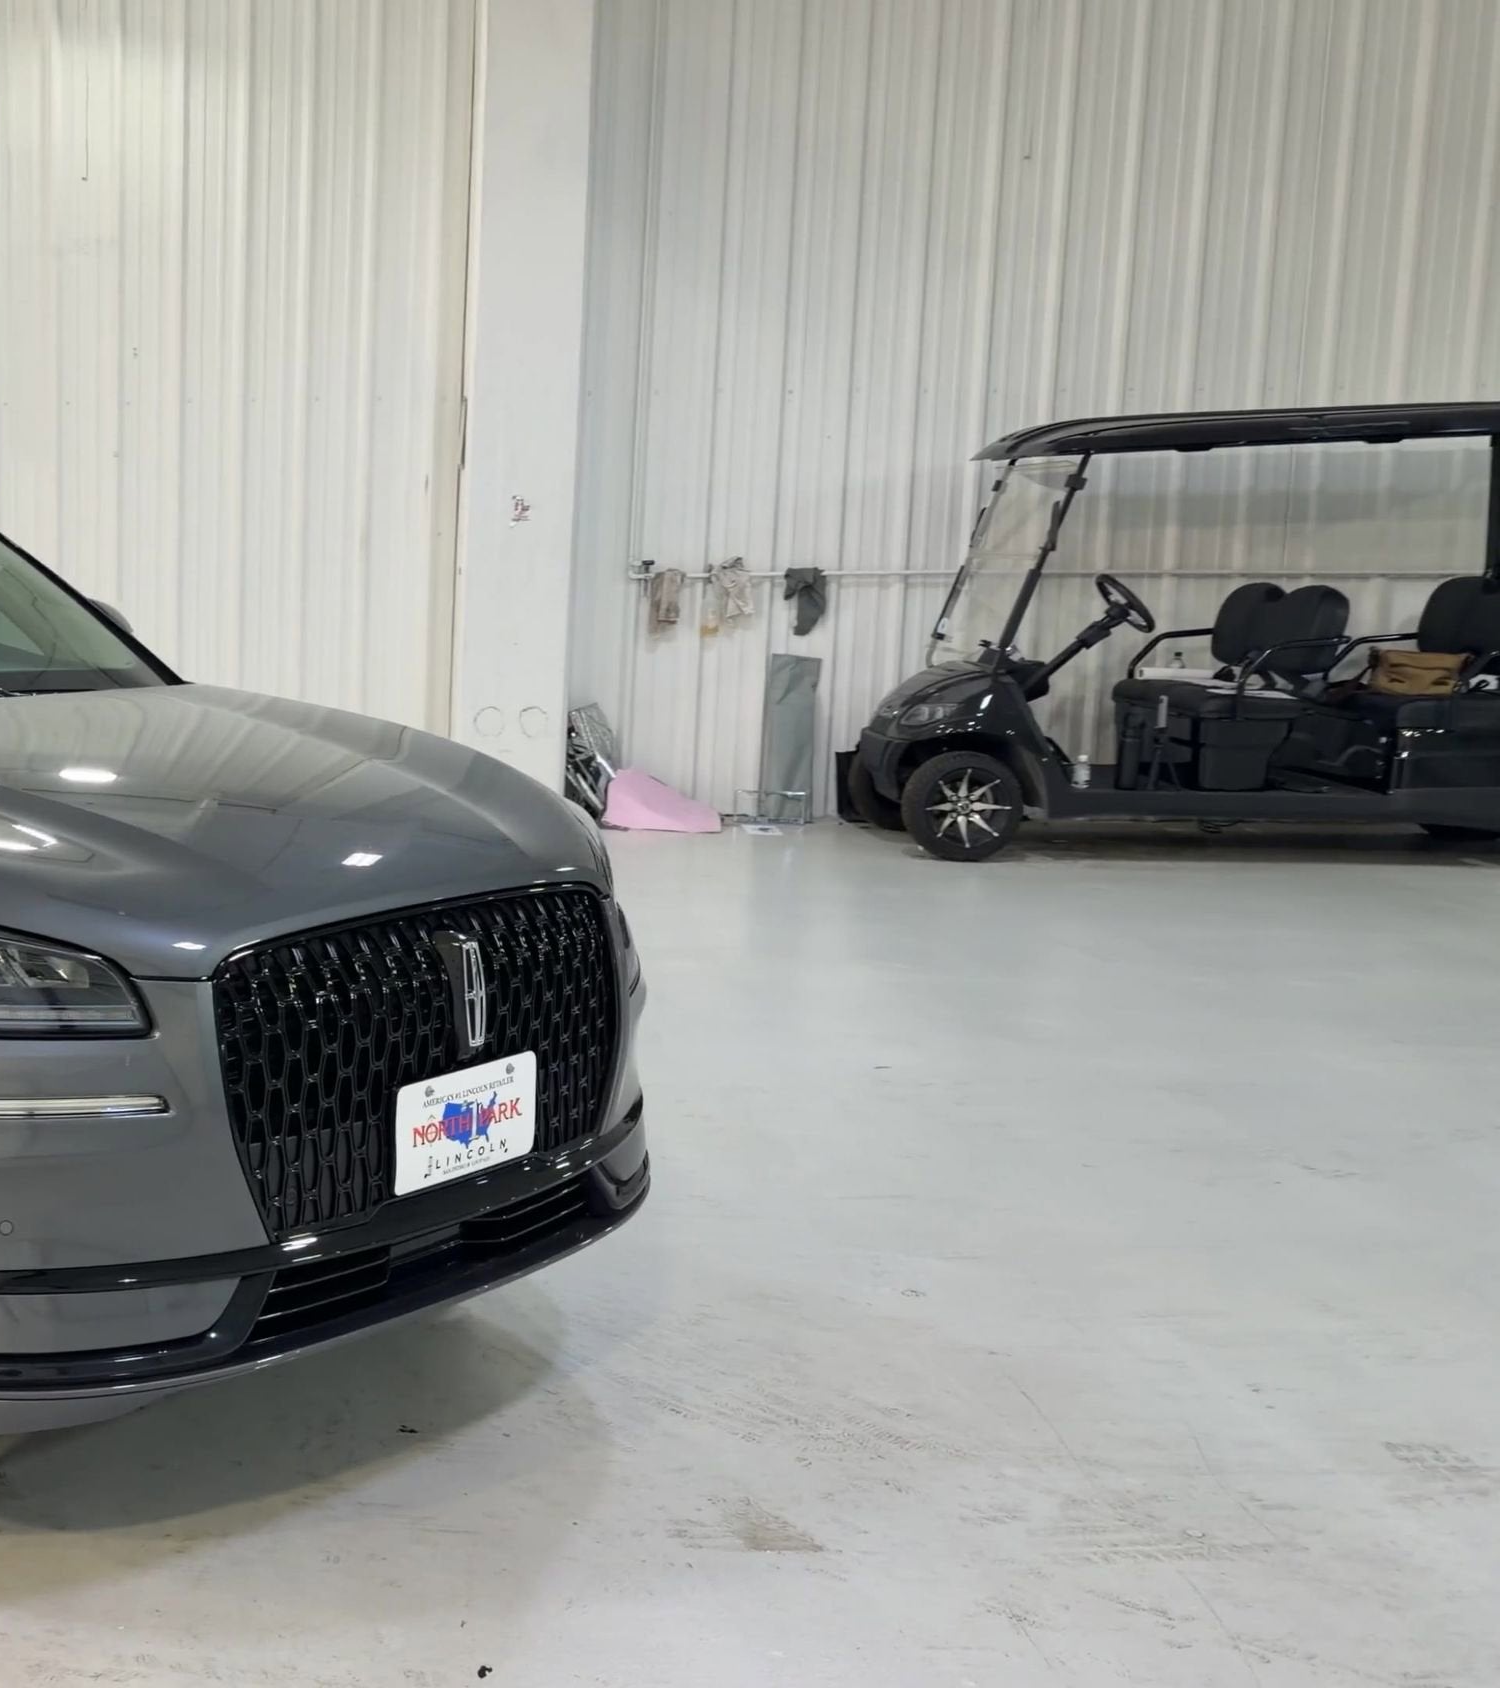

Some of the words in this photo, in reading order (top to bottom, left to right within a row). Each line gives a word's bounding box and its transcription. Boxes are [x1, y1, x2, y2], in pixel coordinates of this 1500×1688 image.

[462, 1085, 488, 1098] LINCOLN
[489, 1076, 514, 1089] RETAILER
[413, 1113, 473, 1148] NORTH
[479, 1097, 523, 1127] PARK
[436, 1138, 506, 1169] LINCOLN
